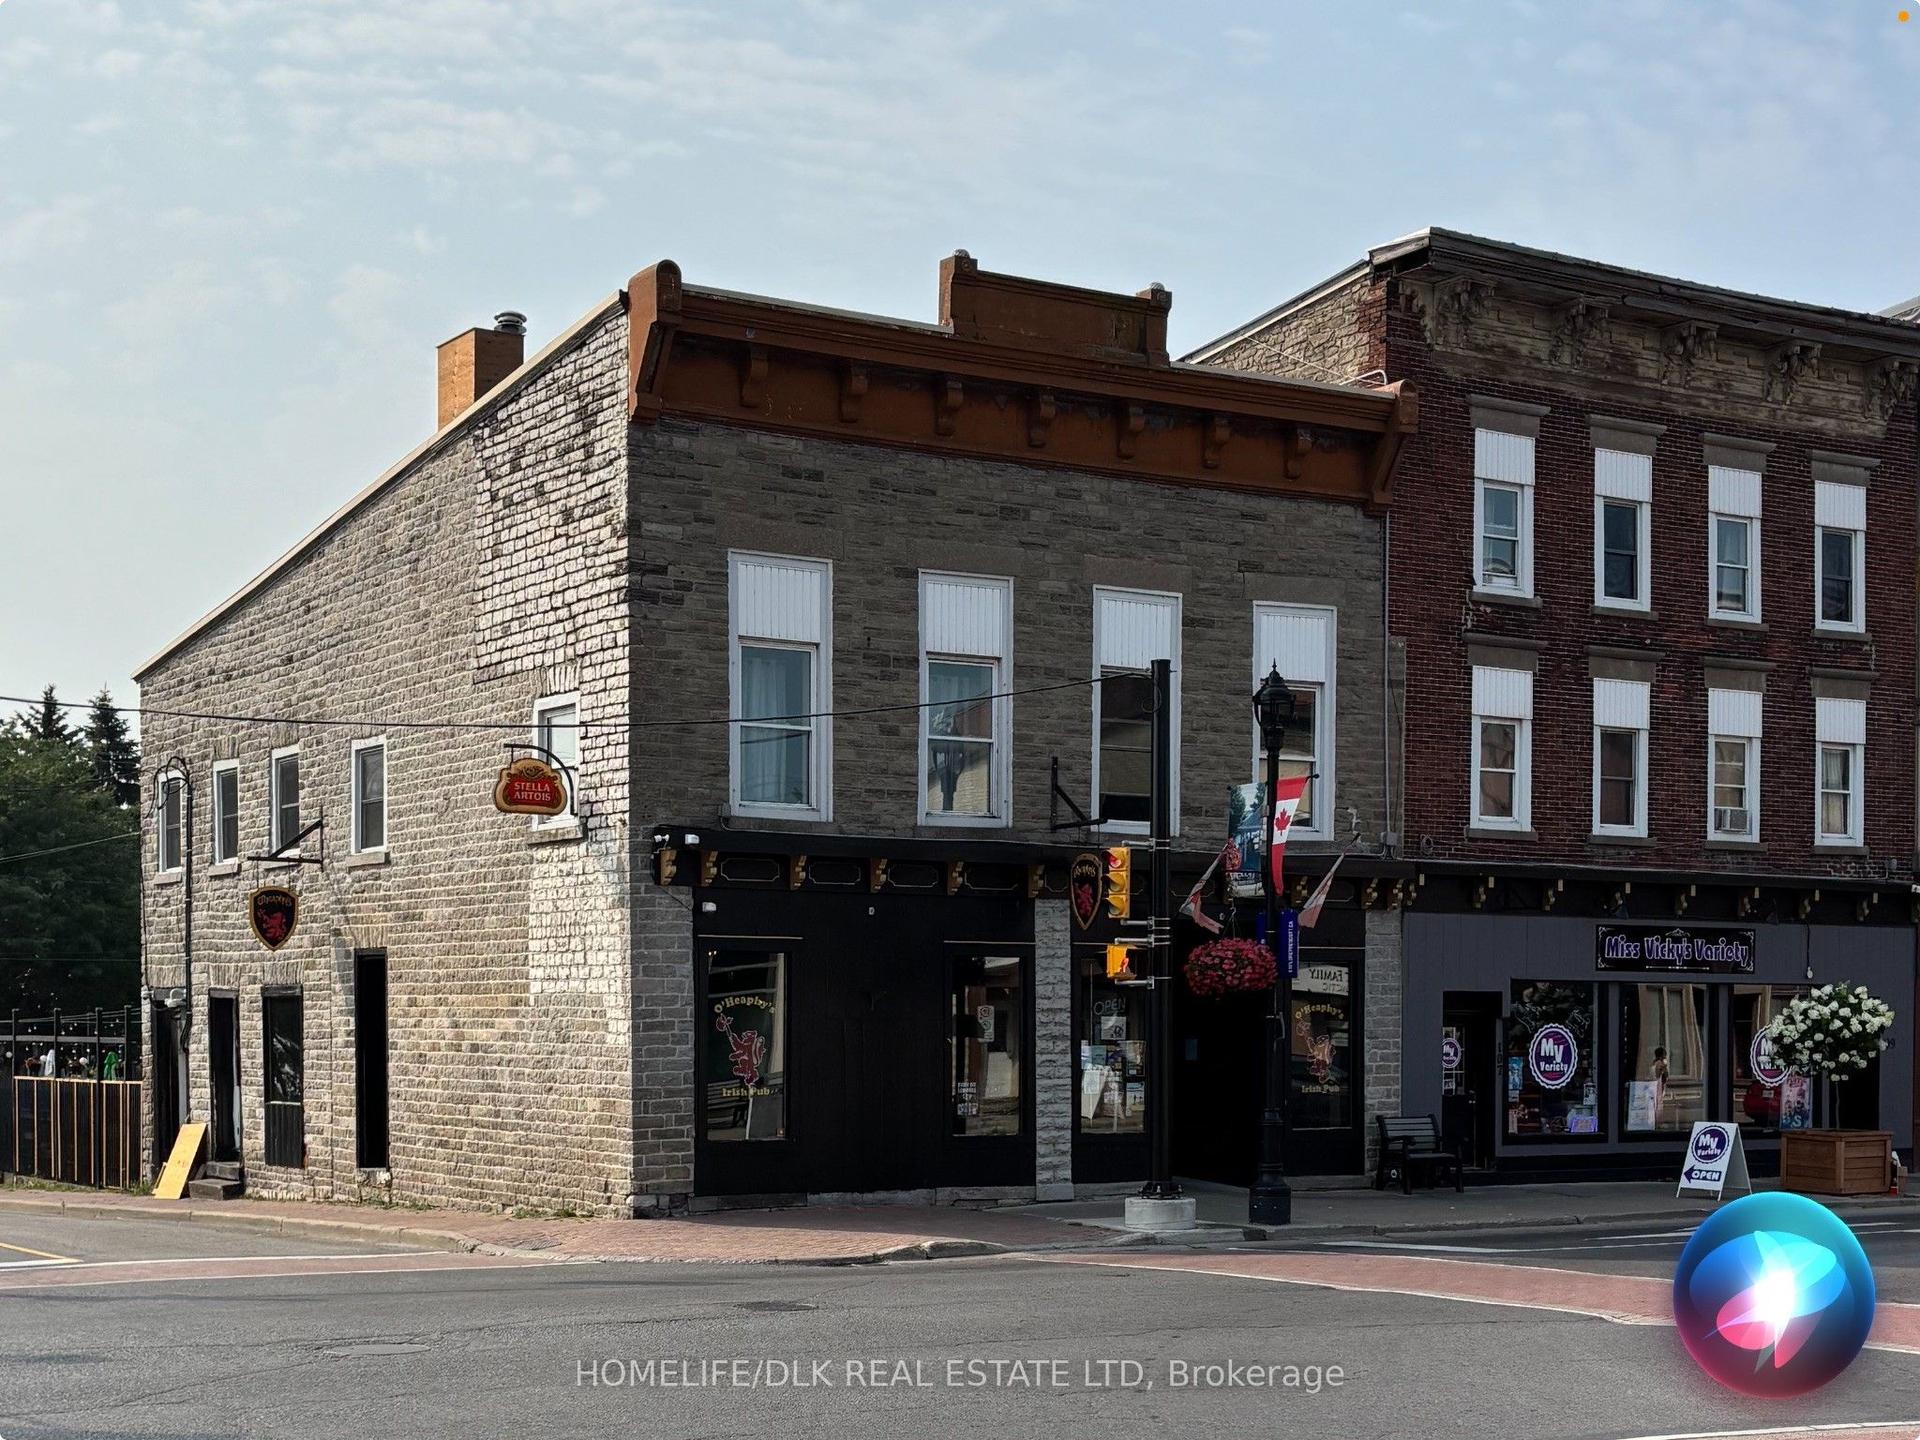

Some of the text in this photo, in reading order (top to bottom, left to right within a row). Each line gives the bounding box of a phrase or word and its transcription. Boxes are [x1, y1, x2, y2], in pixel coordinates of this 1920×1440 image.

[514, 782, 550, 792] STELLA
[513, 791, 551, 801] ARTOIS
[1605, 934, 1749, 967] Miss Vicky's Variety
[1093, 996, 1126, 1015] OPEN
[1540, 1038, 1564, 1062] My
[1540, 1061, 1568, 1073] Variety
[722, 1087, 770, 1097] Irish Pub
[1699, 1133, 1719, 1149] My
[1691, 1170, 1720, 1181] OPEN
